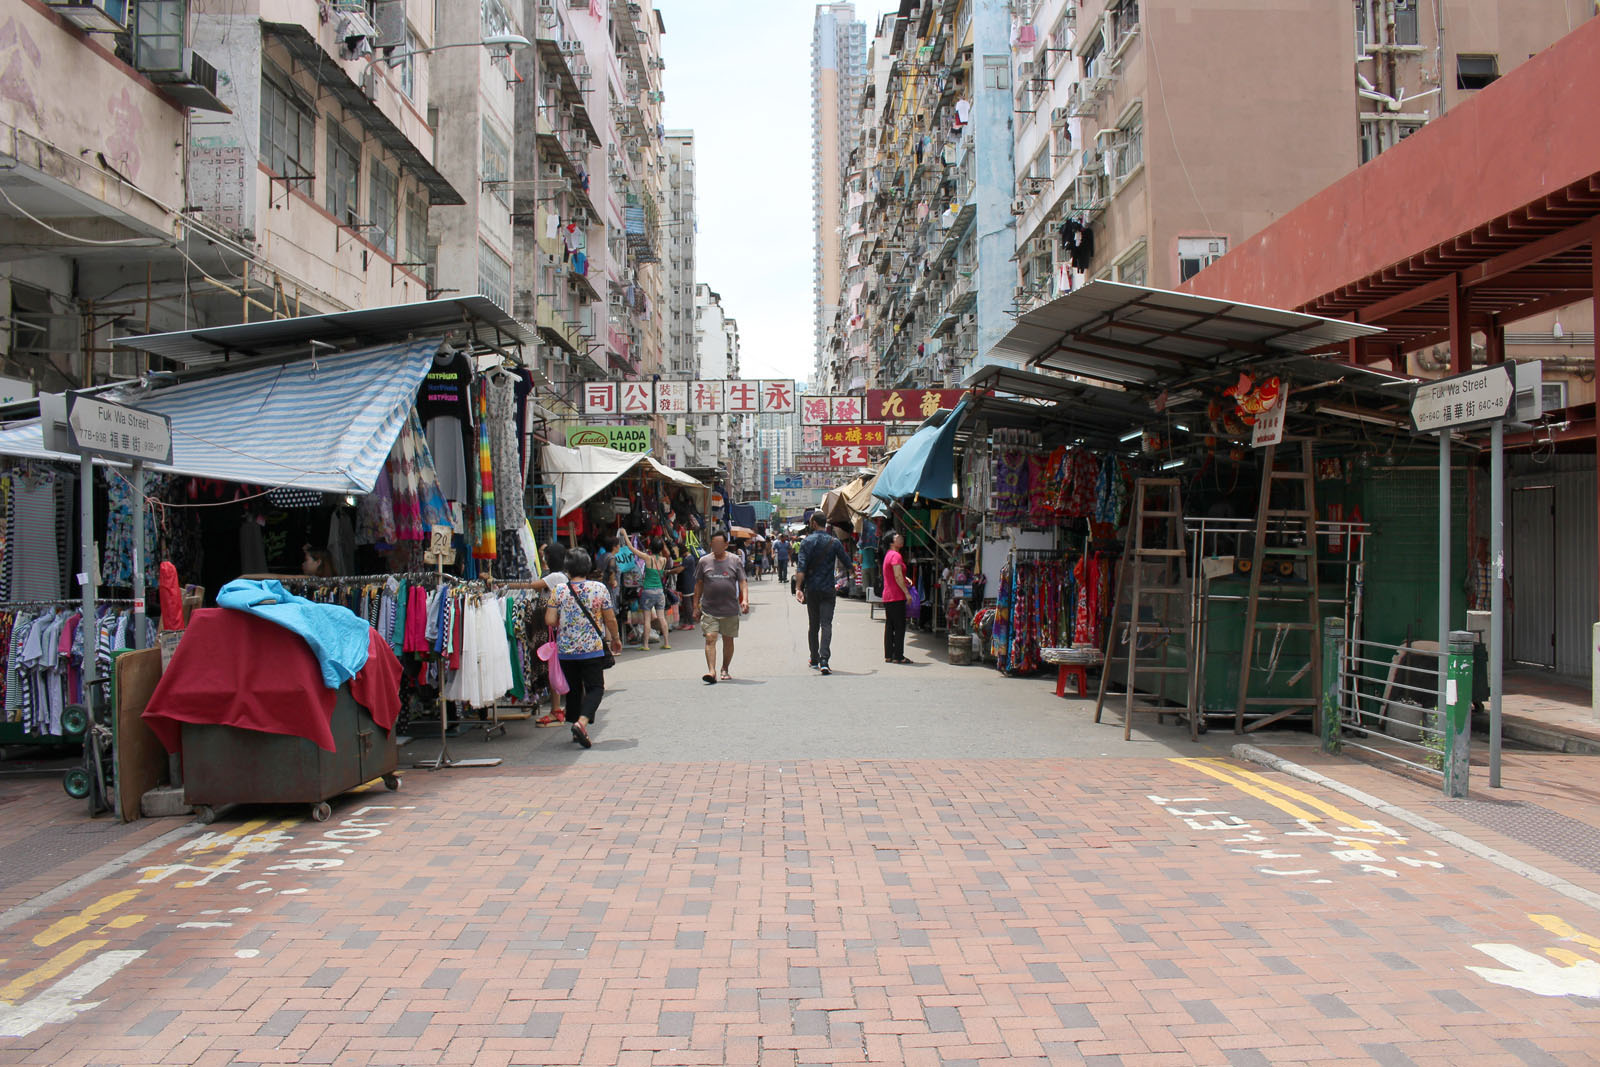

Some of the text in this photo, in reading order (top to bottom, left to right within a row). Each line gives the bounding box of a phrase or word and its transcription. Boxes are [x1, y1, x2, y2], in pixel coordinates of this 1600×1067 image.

[695, 383, 791, 411] 永生祥
[1432, 376, 1488, 400] Fuk Wa Street
[98, 406, 150, 430] Fuk Wa Street
[1443, 401, 1476, 421] 福華街
[110, 431, 141, 452] 福華街
[610, 431, 646, 441] LAADA
[611, 442, 647, 452] SHOP
[434, 532, 448, 546] 20
